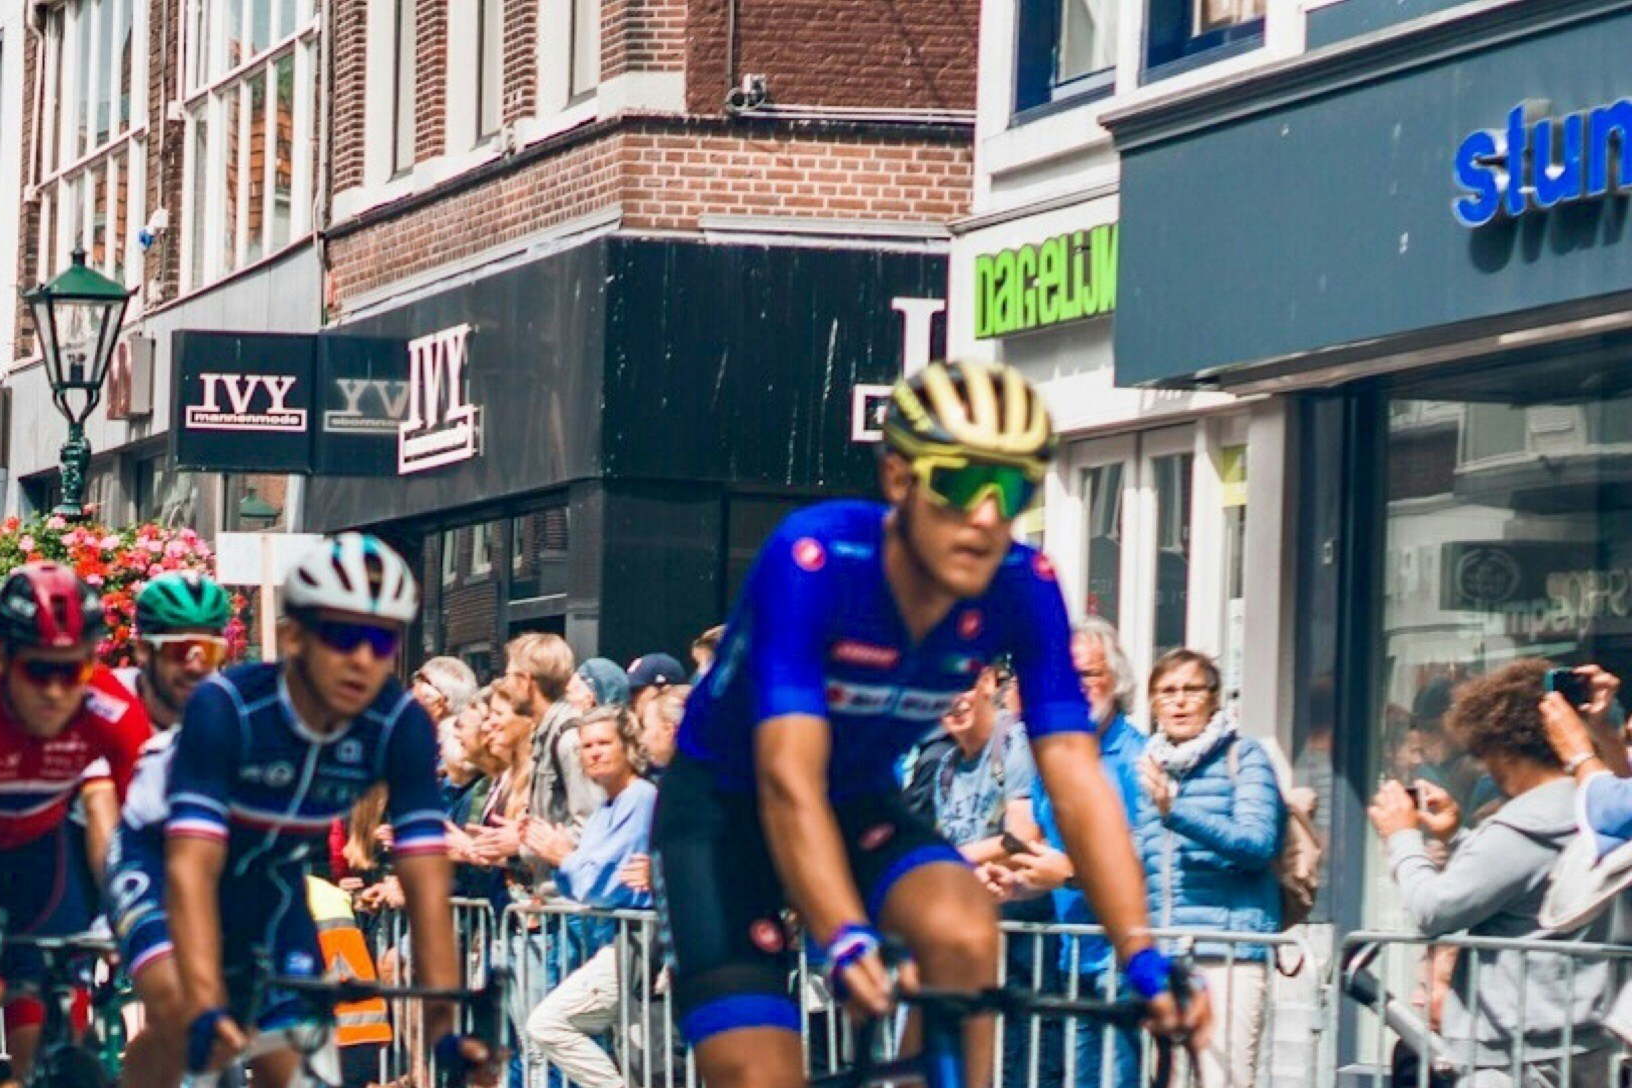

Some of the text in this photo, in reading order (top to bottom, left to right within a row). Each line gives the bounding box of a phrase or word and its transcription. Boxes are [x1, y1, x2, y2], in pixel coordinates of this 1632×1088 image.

[199, 373, 296, 414] IVY
[406, 323, 472, 430] IVY
[194, 411, 300, 426] mannenmode
